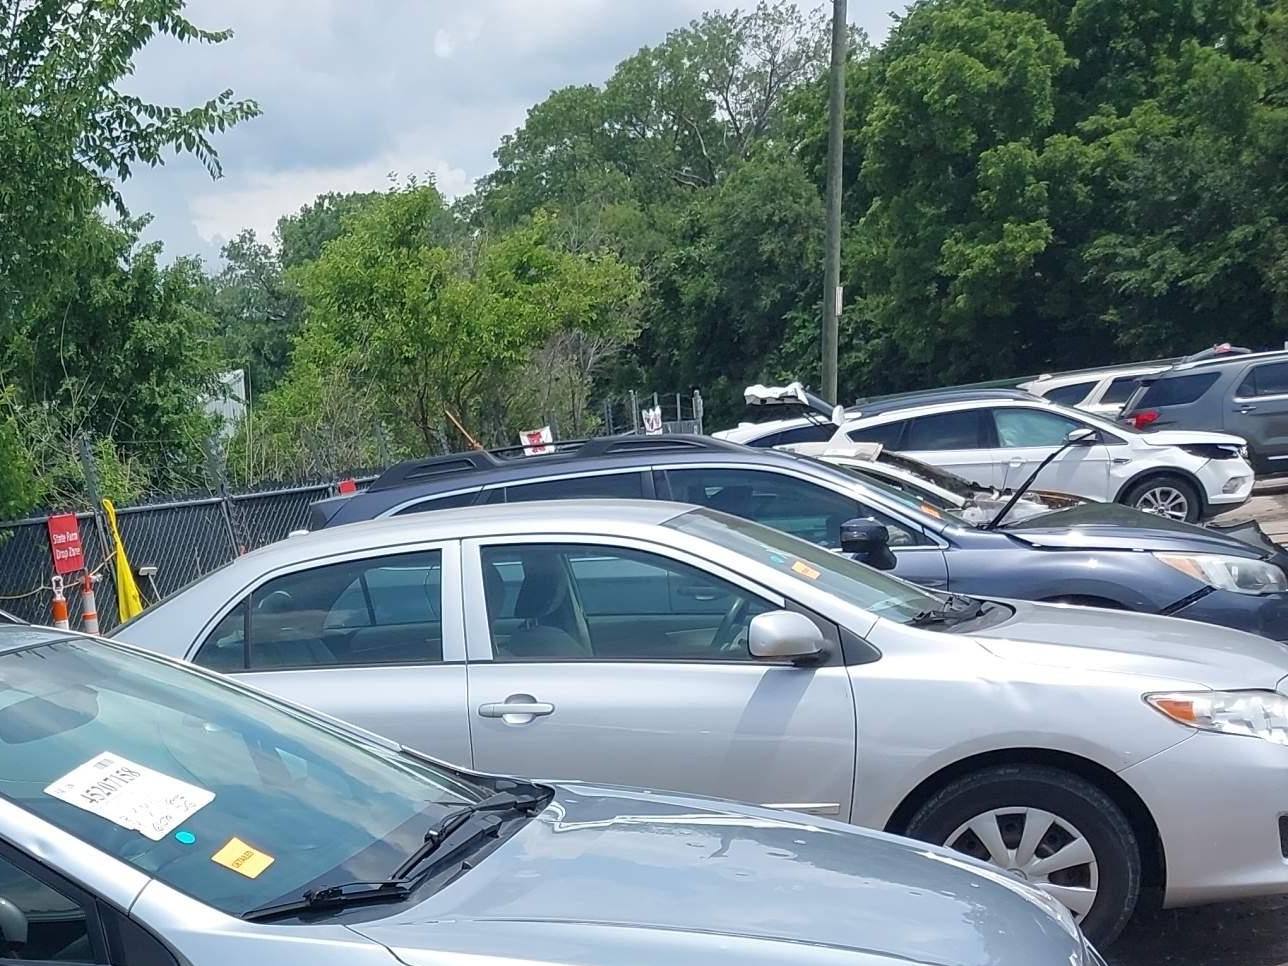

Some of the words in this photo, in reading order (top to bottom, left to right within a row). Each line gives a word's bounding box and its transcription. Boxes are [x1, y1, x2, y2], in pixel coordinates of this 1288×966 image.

[53, 534, 66, 545] State
[66, 532, 78, 542] Farm
[55, 549, 68, 560] Drop
[80, 767, 141, 804] 45207158
